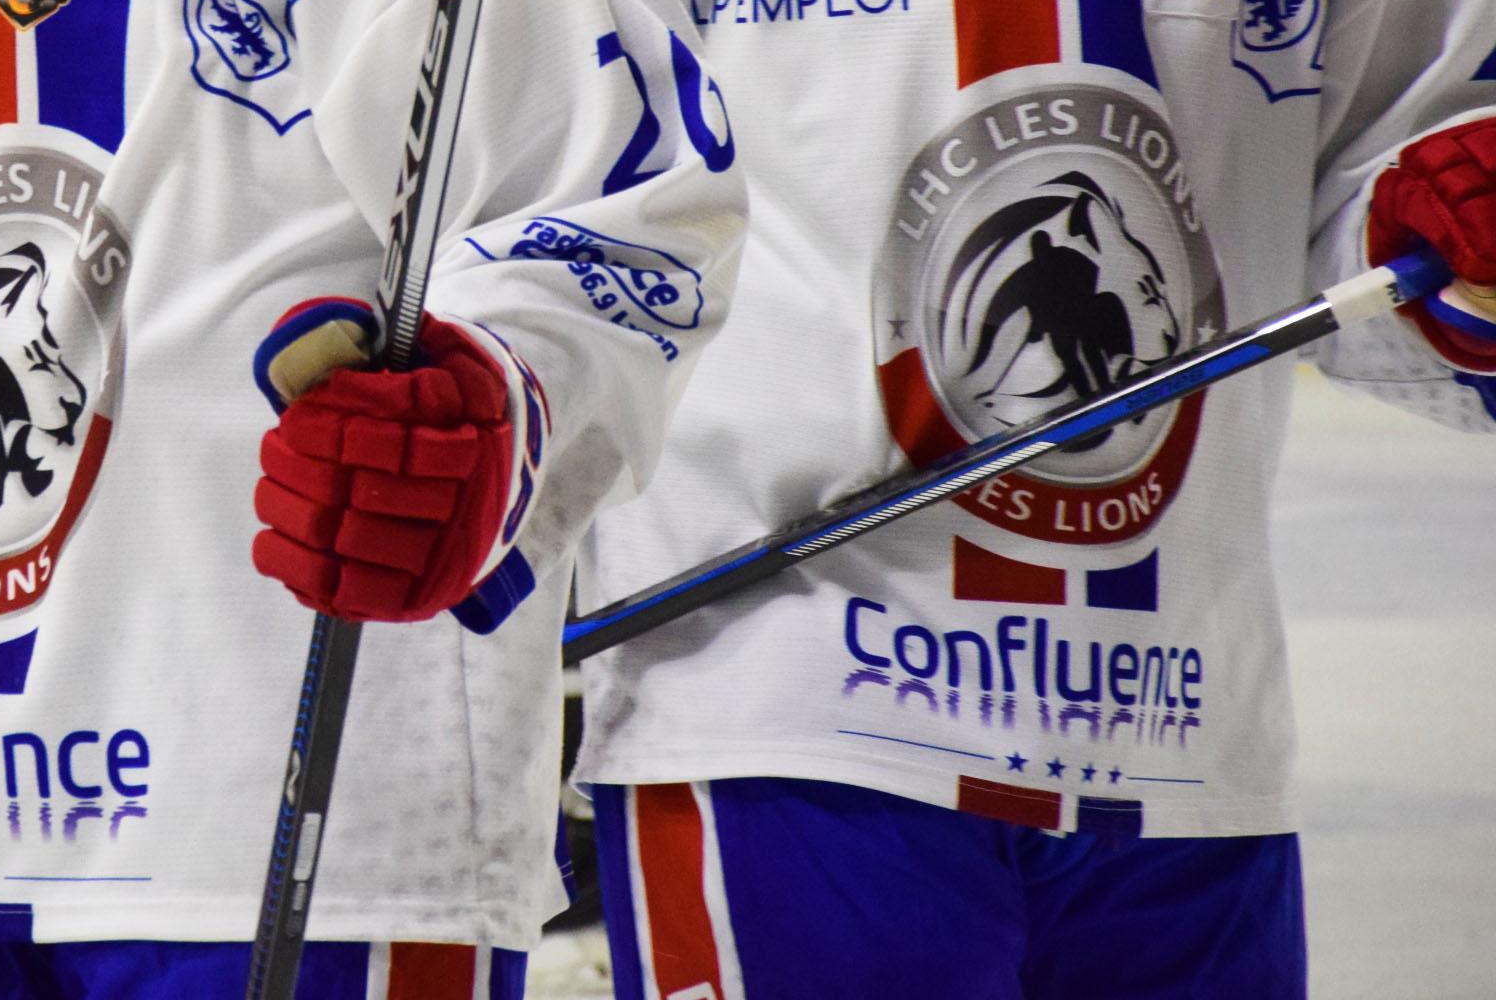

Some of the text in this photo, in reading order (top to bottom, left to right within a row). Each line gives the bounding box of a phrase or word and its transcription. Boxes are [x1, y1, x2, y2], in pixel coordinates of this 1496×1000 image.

[378, 7, 449, 310] EXUS
[897, 137, 979, 242] LHC
[985, 98, 1080, 151] LES
[963, 472, 1163, 533] ES LIONS
[845, 597, 1203, 710] Confluence
